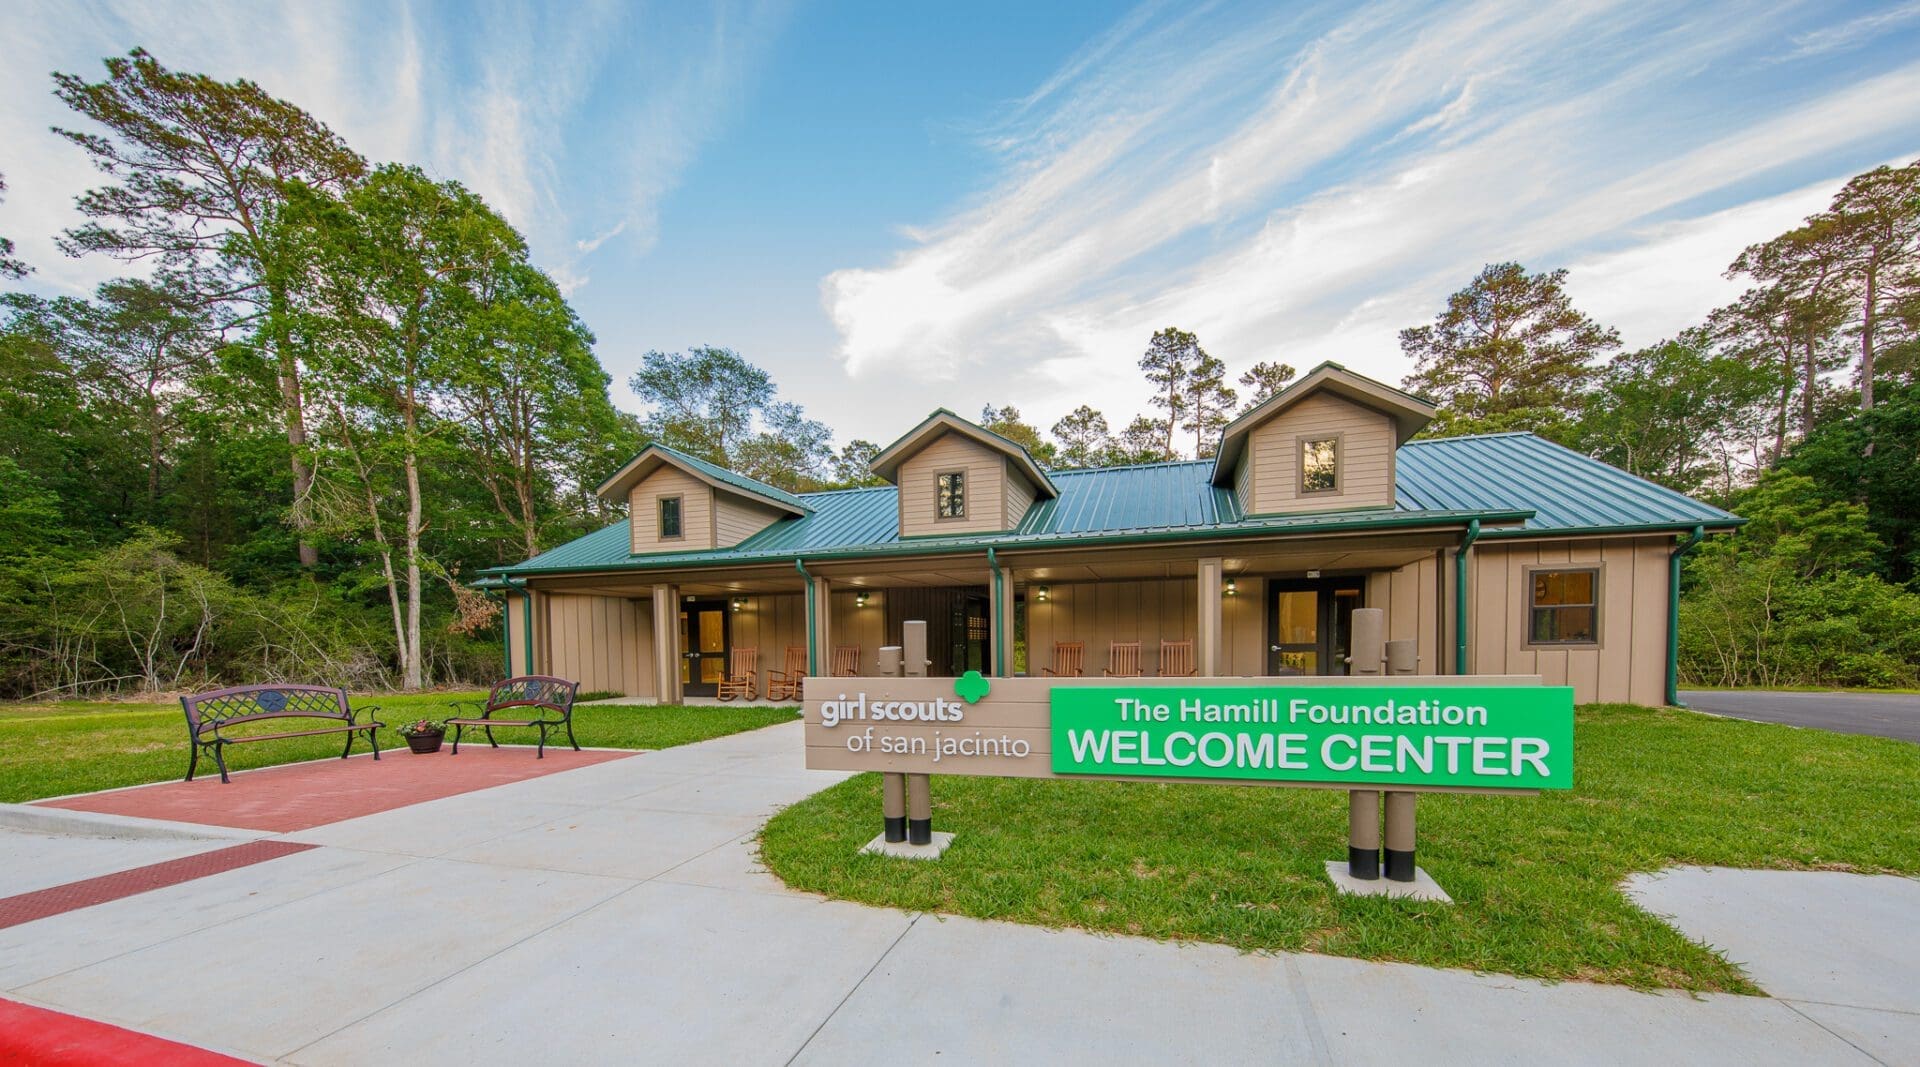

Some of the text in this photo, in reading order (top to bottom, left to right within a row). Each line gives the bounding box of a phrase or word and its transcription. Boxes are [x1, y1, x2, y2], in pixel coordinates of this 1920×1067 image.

[820, 693, 964, 728] girl scouts
[1115, 699, 1488, 726] The Hamill Foundation
[847, 727, 1030, 762] of san jacinto
[1068, 730, 1551, 777] WELCOME CENTER
